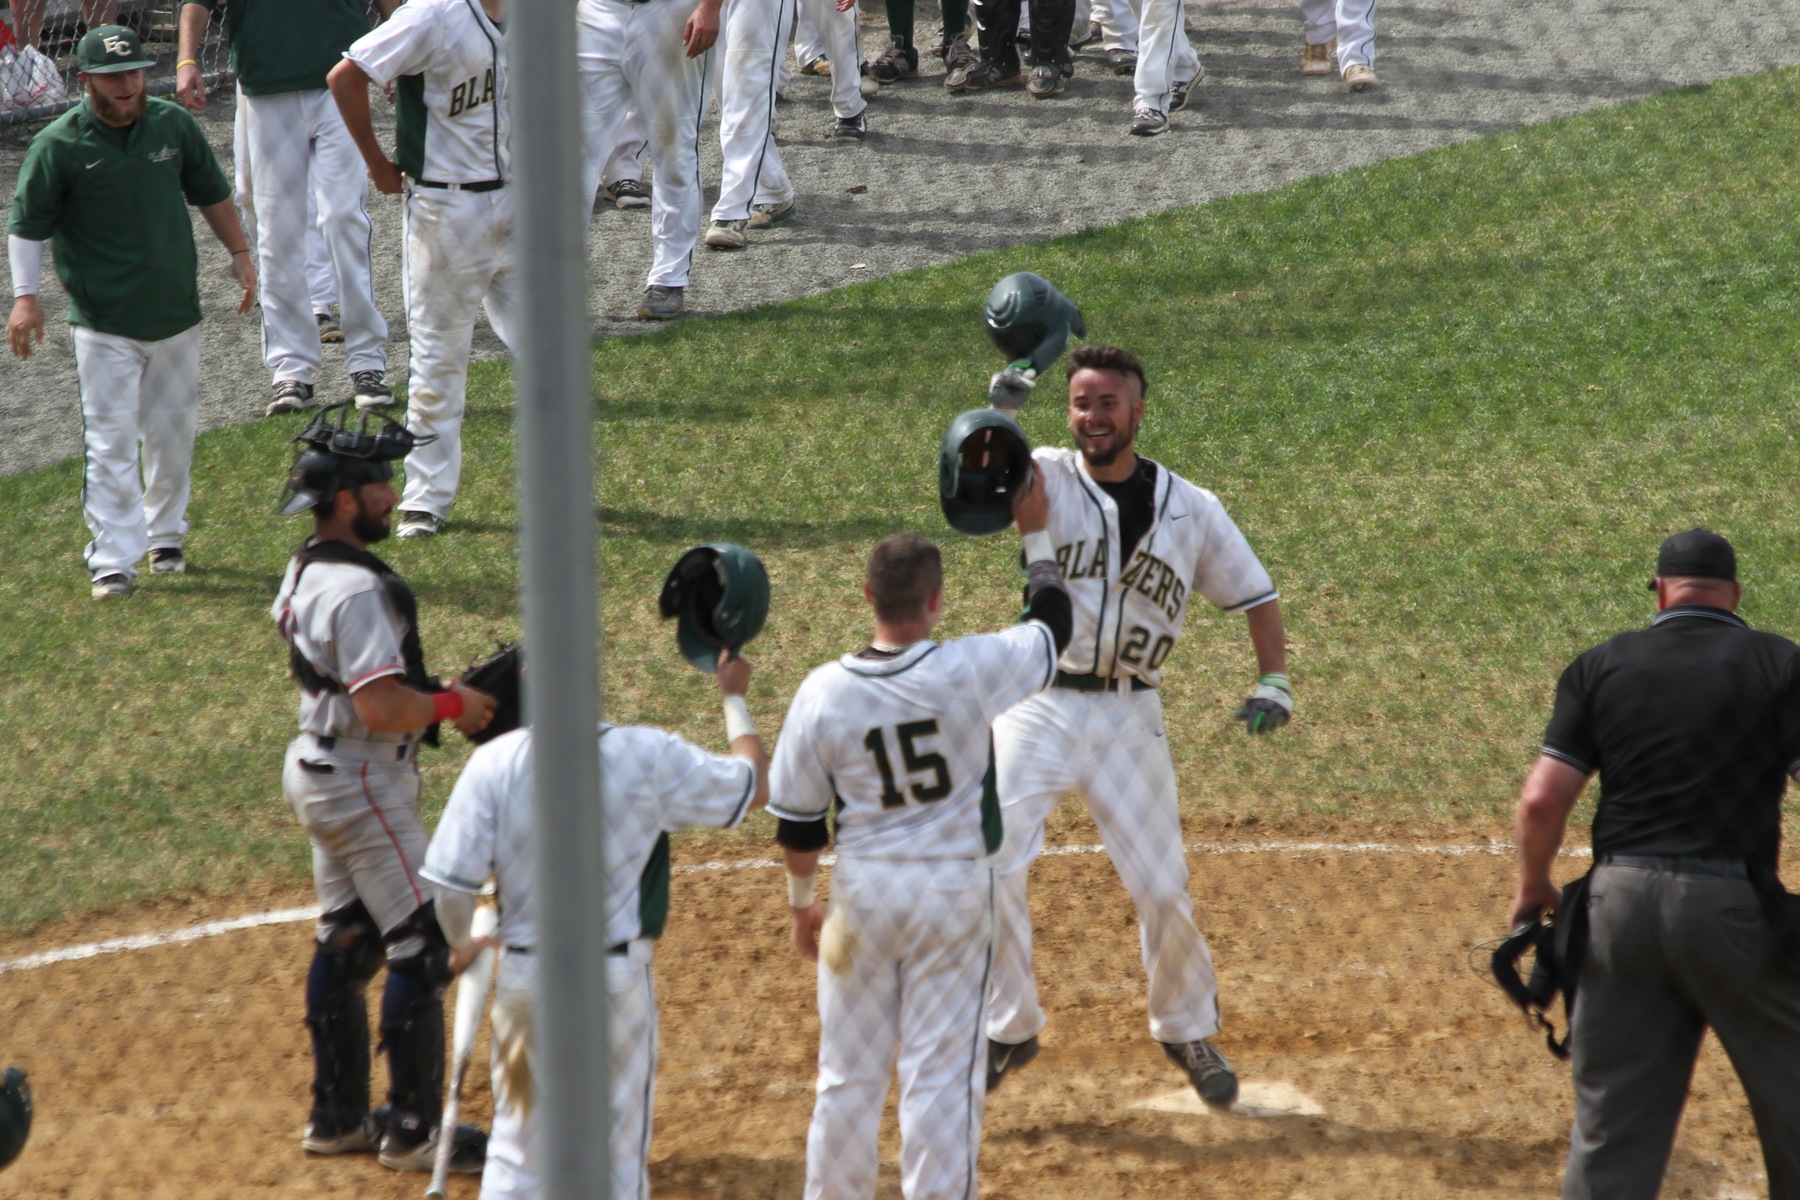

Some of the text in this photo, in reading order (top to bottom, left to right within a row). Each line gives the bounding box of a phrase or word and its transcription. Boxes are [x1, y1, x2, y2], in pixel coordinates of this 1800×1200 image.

[102, 35, 133, 57] EC
[448, 66, 508, 117] BLA
[1119, 625, 1175, 672] 20
[864, 718, 953, 810] 15
